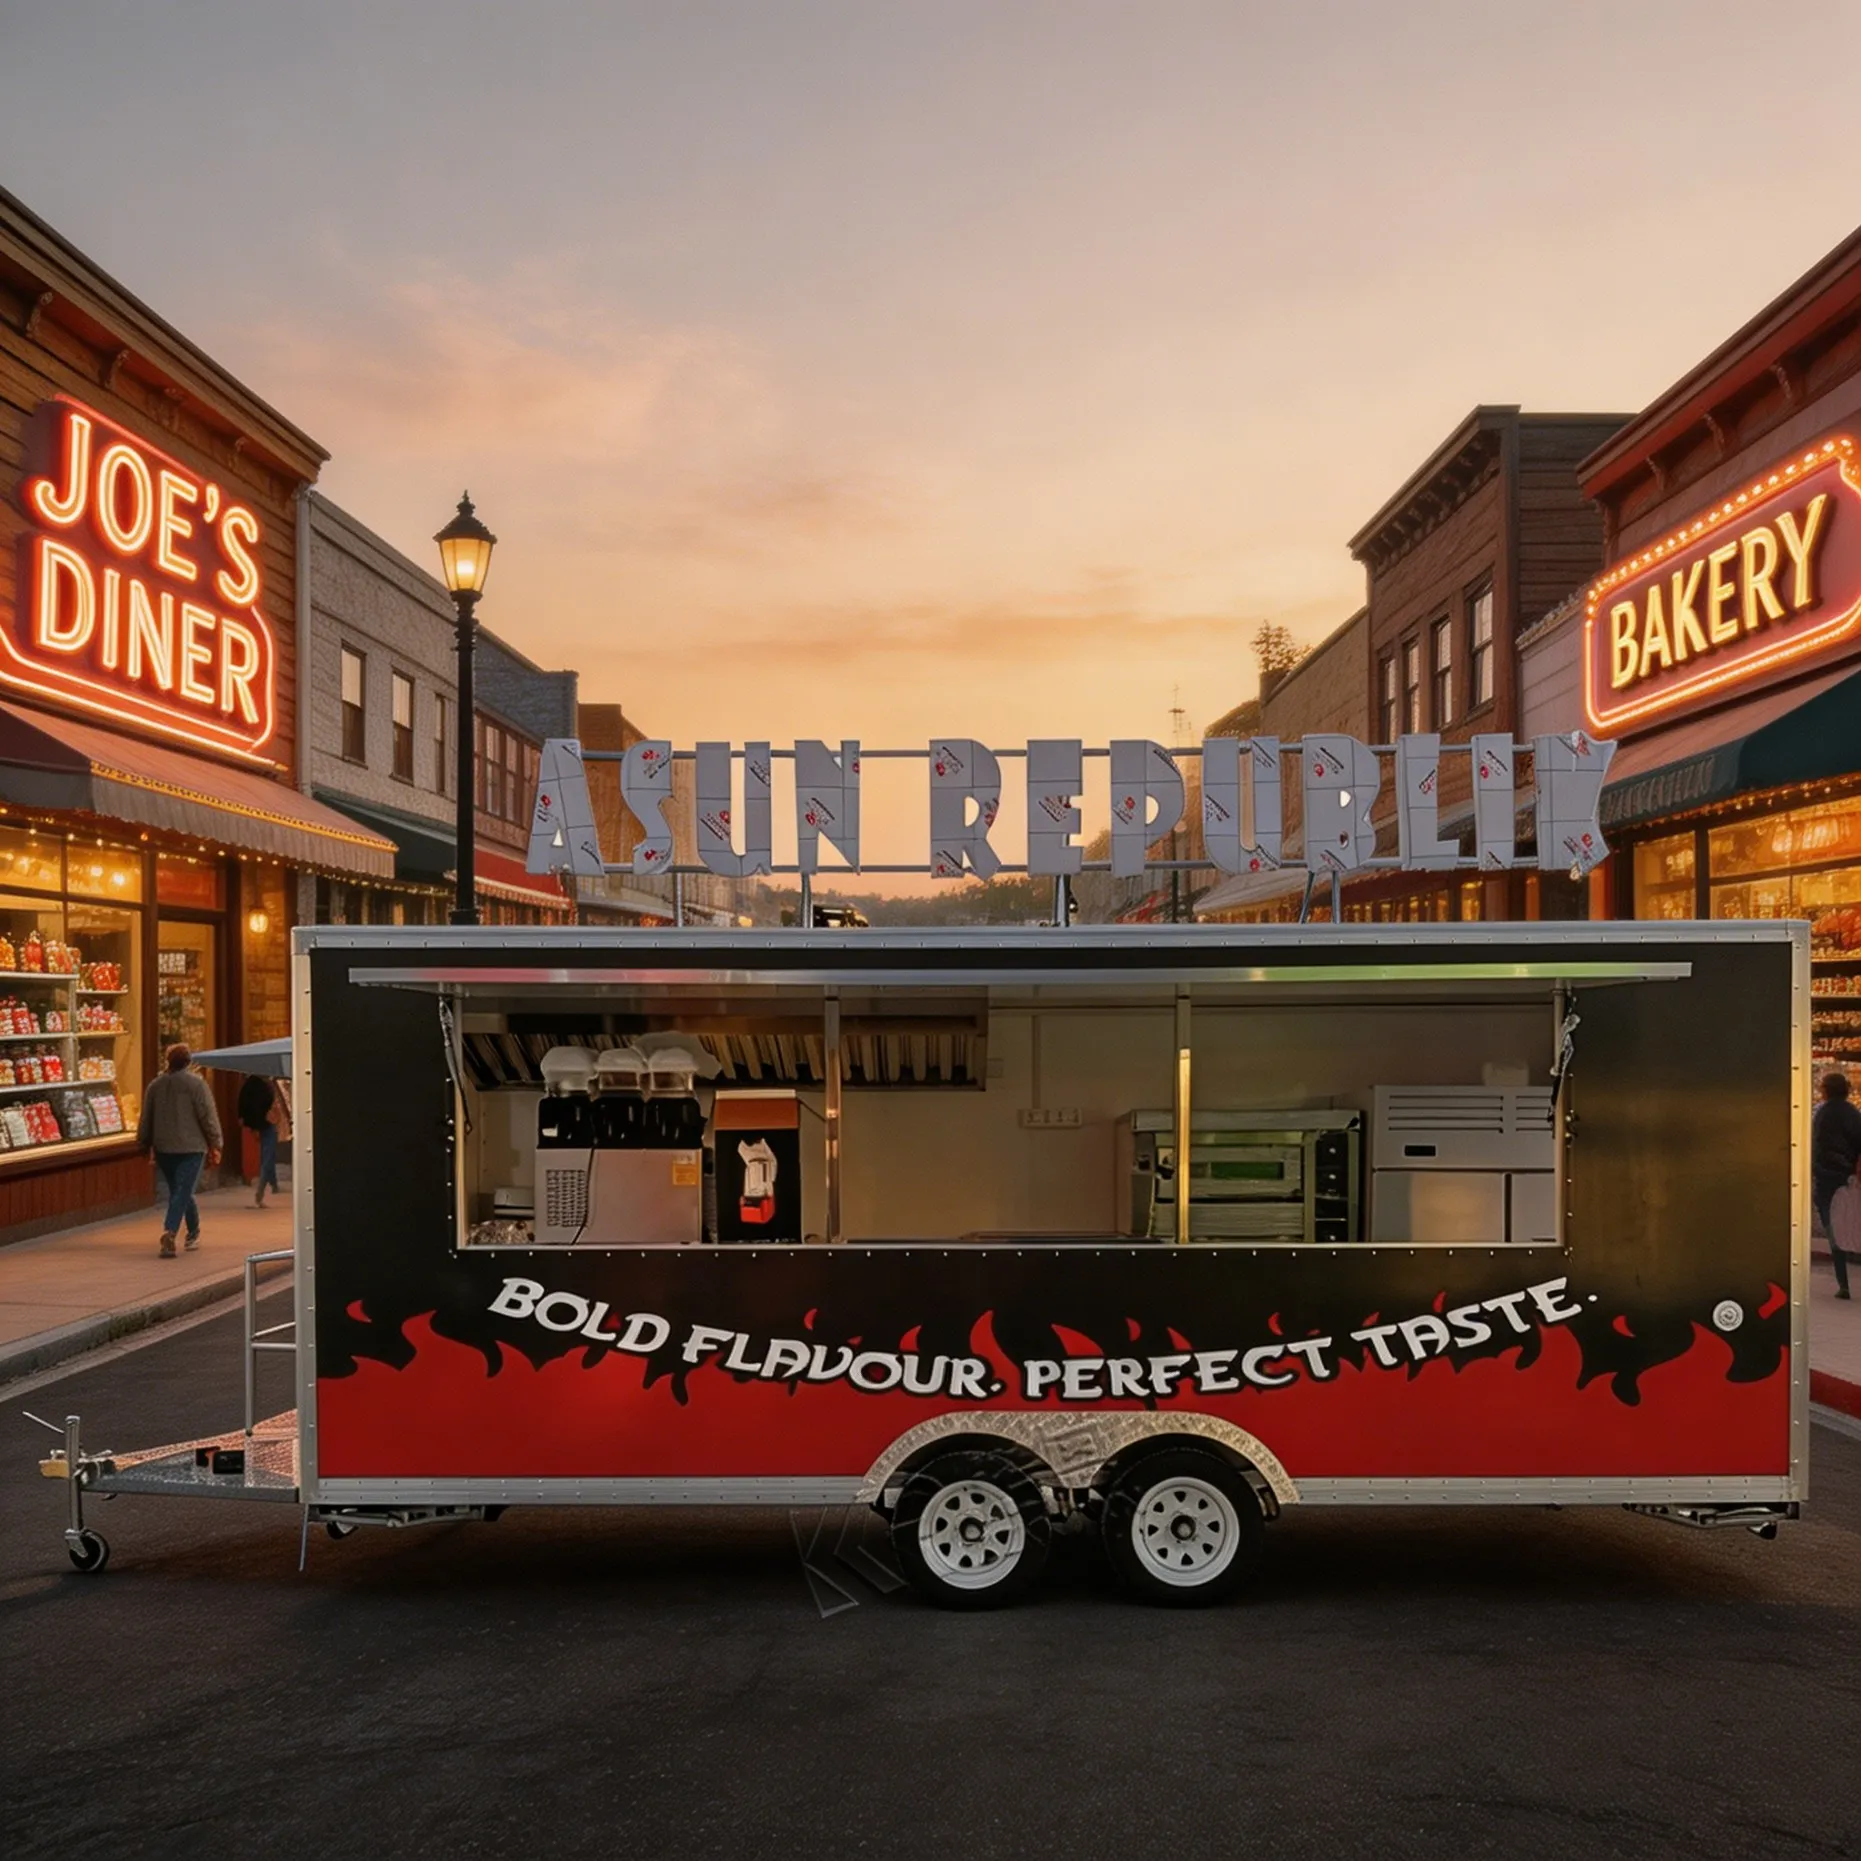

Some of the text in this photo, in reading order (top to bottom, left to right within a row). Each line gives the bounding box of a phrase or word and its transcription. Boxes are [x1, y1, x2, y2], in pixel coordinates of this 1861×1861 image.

[34, 413, 259, 604] JOE'S
[1610, 493, 1827, 689] BAKERY
[39, 538, 260, 724] DINER
[527, 738, 861, 877] ASUN
[488, 1276, 1599, 1400] BOLD FLAVOUR. PERFECT TASTE.
